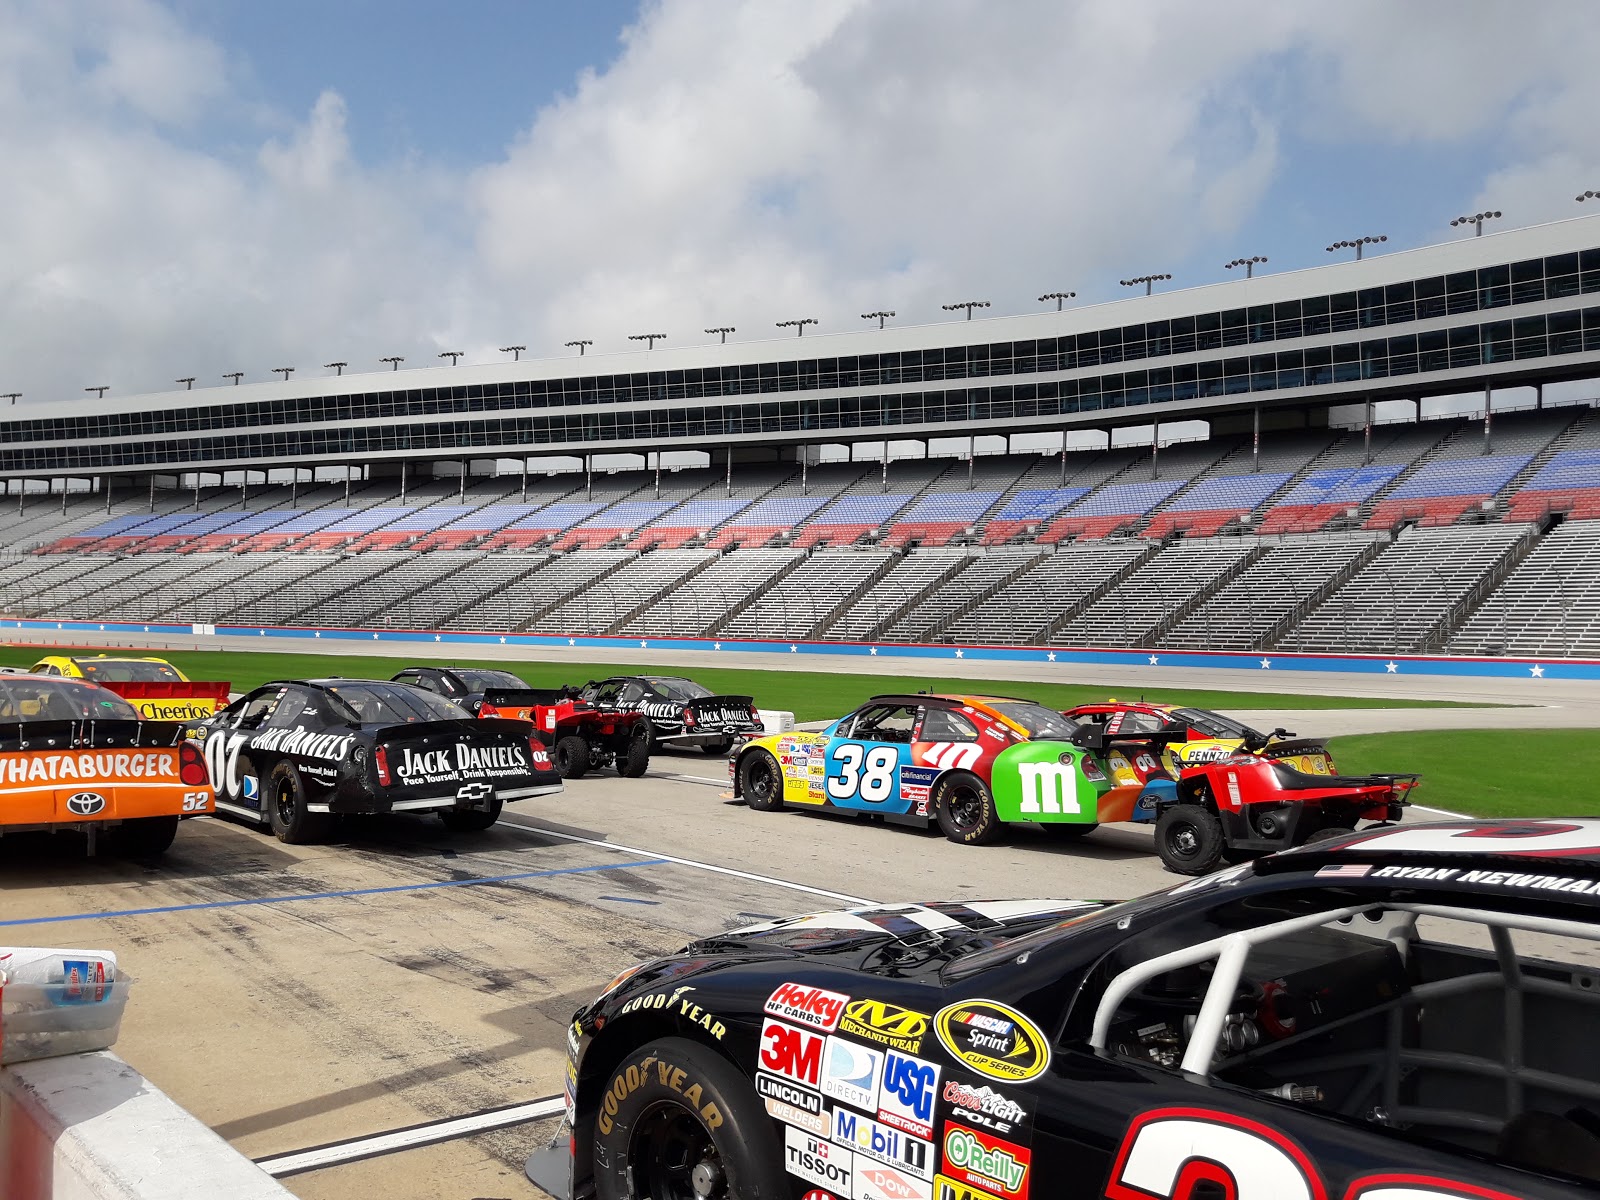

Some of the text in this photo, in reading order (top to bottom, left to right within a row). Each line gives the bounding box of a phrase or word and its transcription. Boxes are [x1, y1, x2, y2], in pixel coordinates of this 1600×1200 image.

[140, 702, 212, 720] Cheerios
[697, 710, 720, 723] JACK
[721, 708, 750, 721] DANIEL'S
[251, 725, 357, 761] JACK DANIEL'S
[205, 730, 249, 798] 07
[397, 748, 453, 778] JACK
[455, 742, 527, 770] DANIEL'S
[780, 755, 793, 766] 3M
[827, 743, 898, 803] 38
[403, 777, 424, 786] Pace
[463, 769, 486, 779] Drink
[1017, 761, 1081, 814] m
[182, 792, 209, 811] 52
[808, 790, 825, 799] Stant
[936, 781, 948, 809] EAGLE
[1371, 866, 1460, 880] RYAN
[767, 1002, 822, 1025] HP CARBS
[771, 984, 845, 1027] Holley
[839, 1017, 921, 1054] MECHANIX WEAR
[967, 1014, 1011, 1035] NASCAR
[761, 1024, 823, 1085] 3M
[967, 1029, 1009, 1052] Sprint
[966, 1054, 1027, 1077] CUP SERIES
[760, 1079, 818, 1112] LINCOLN
[827, 1080, 872, 1106] DIRECTV
[884, 1054, 936, 1122] USG
[943, 1081, 1027, 1123] Coors LIGHT
[772, 1102, 823, 1130] WELDERS
[879, 1111, 931, 1137] SHEETROCK
[952, 1107, 1012, 1133] POLE
[837, 1111, 898, 1158] Mobil
[786, 1145, 850, 1186] TISSOT
[836, 1136, 857, 1150] OFFICIAL
[858, 1146, 877, 1157] MOTOR
[877, 1153, 886, 1161] OIL
[891, 1160, 925, 1177] LUBRICANTS
[949, 1134, 1021, 1187] O'Reilly
[966, 1173, 982, 1185] AUTO
[981, 1178, 1002, 1192] PARTS
